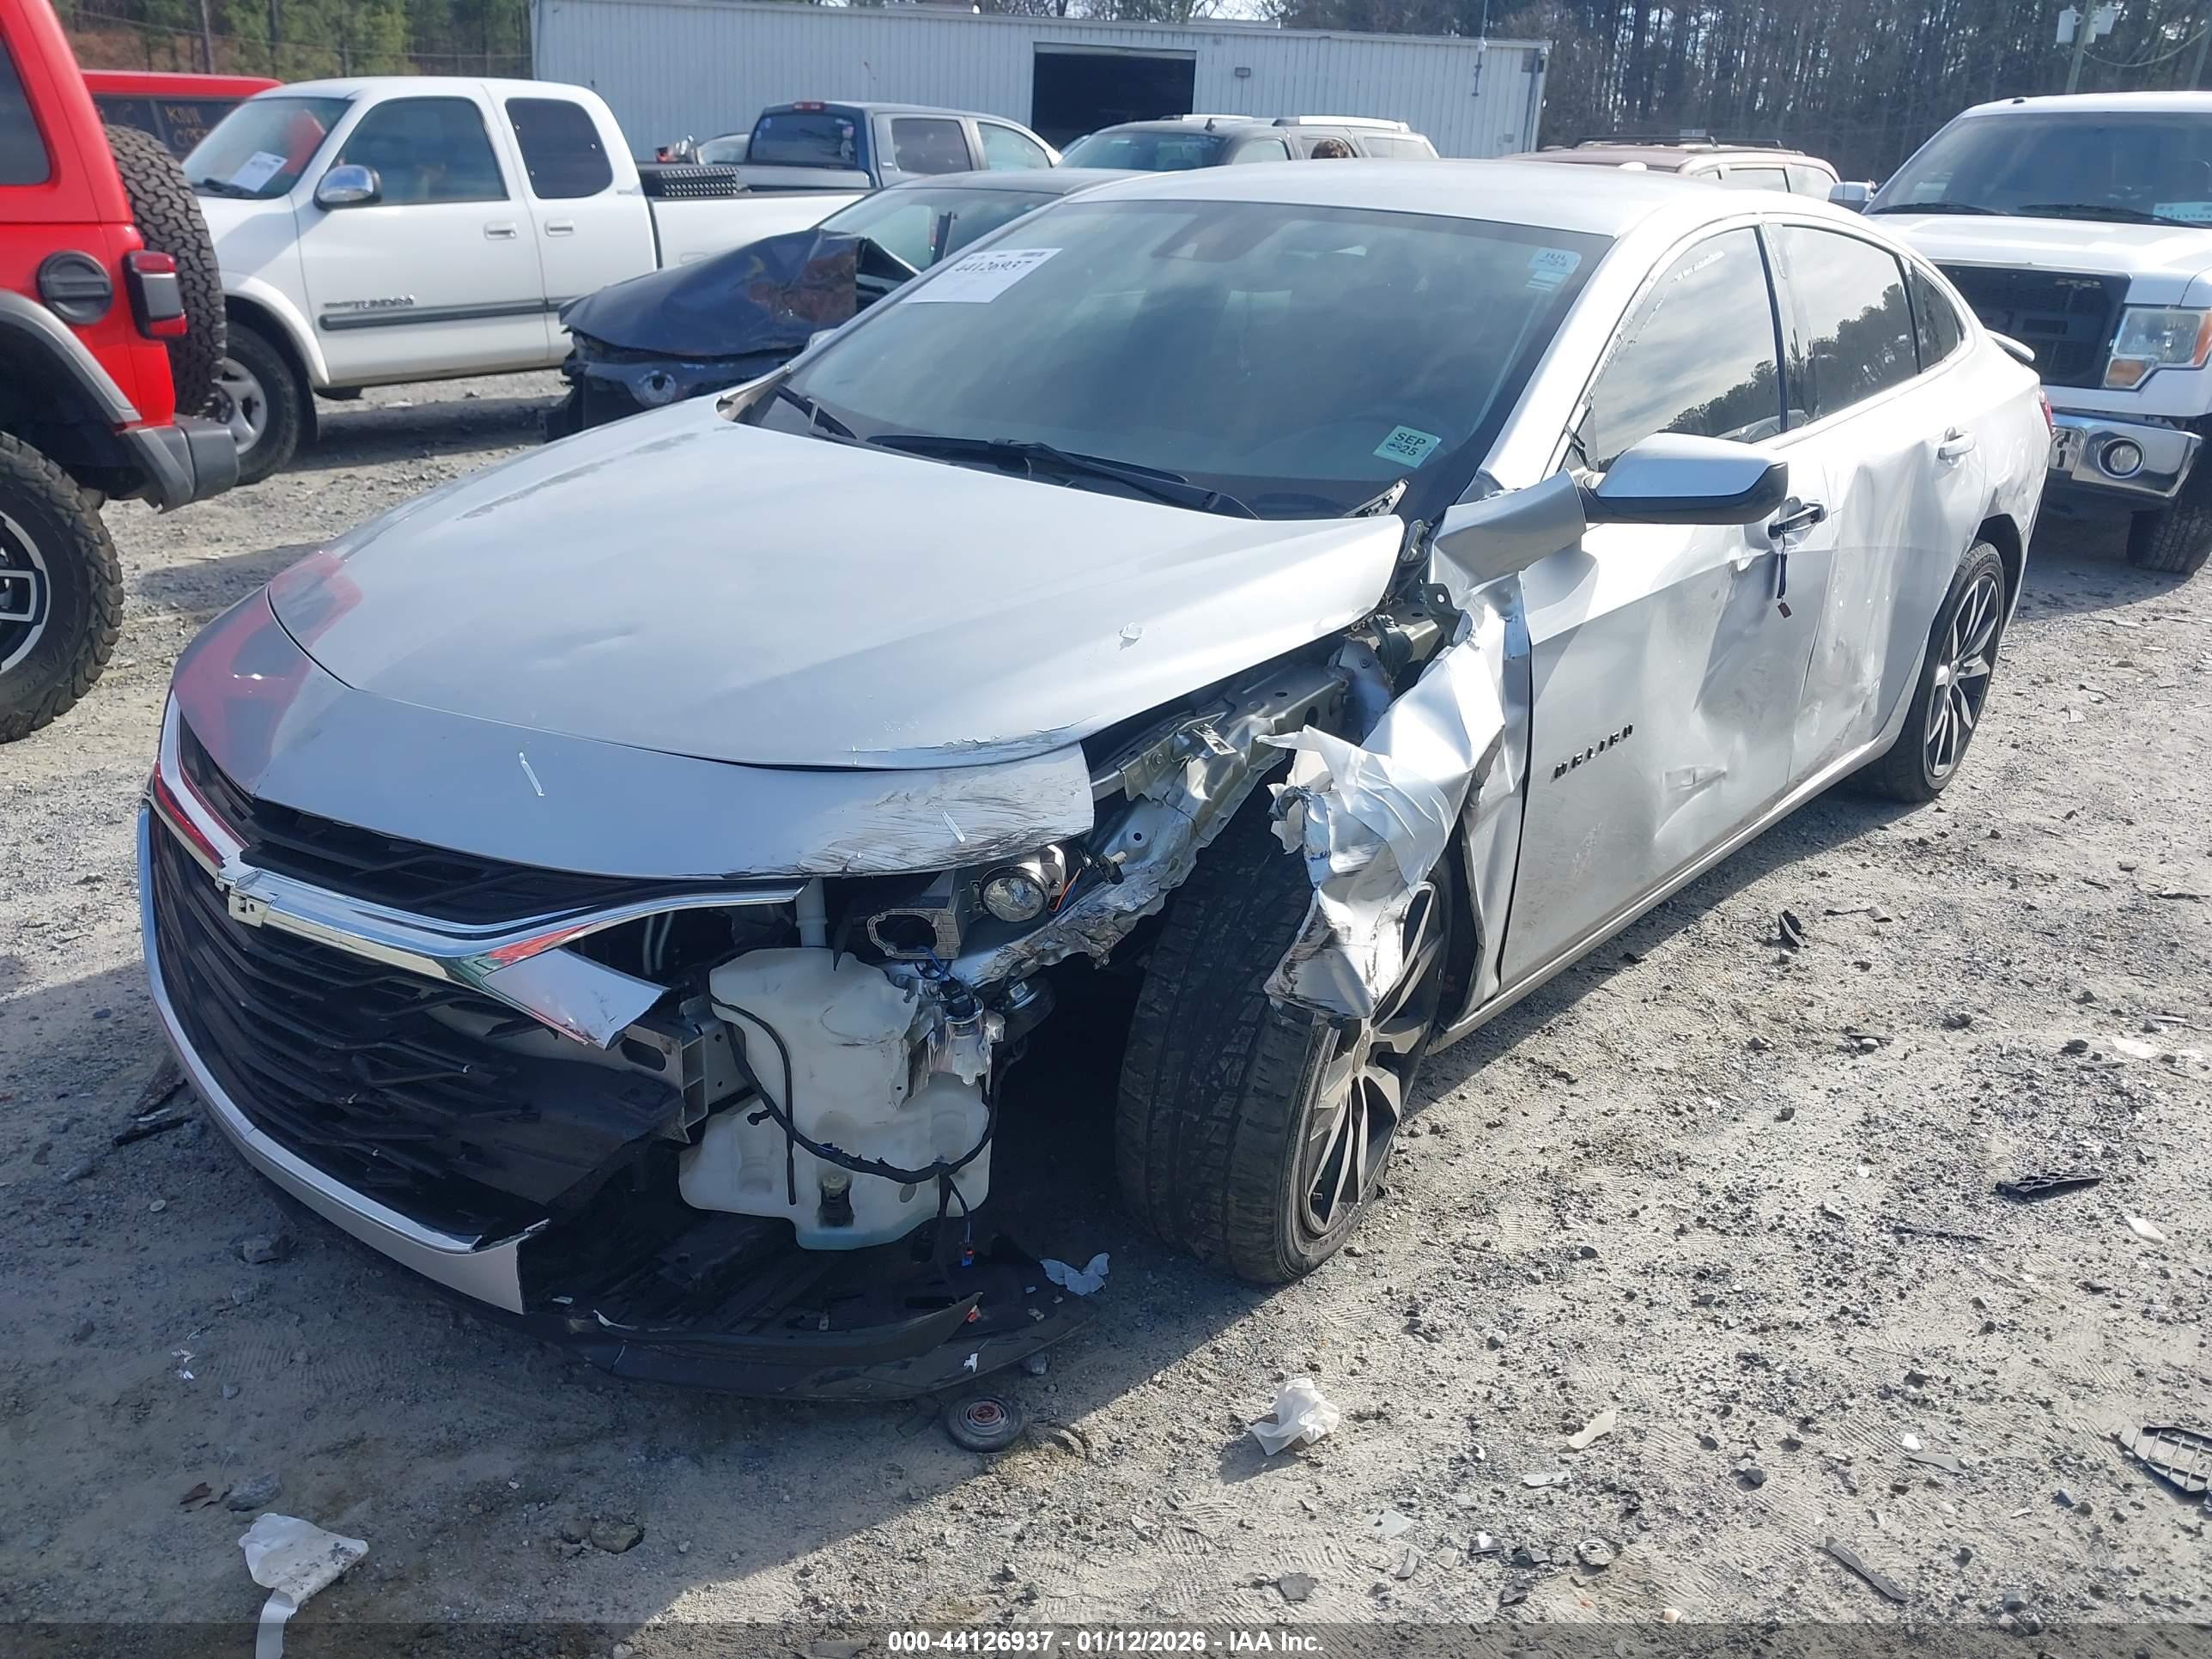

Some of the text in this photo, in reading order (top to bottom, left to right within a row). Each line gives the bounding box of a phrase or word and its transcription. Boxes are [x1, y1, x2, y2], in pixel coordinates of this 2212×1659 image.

[1394, 432, 1426, 447] SEP
[1399, 444, 1419, 457] 25
[1553, 722, 1634, 780] MALIBU
